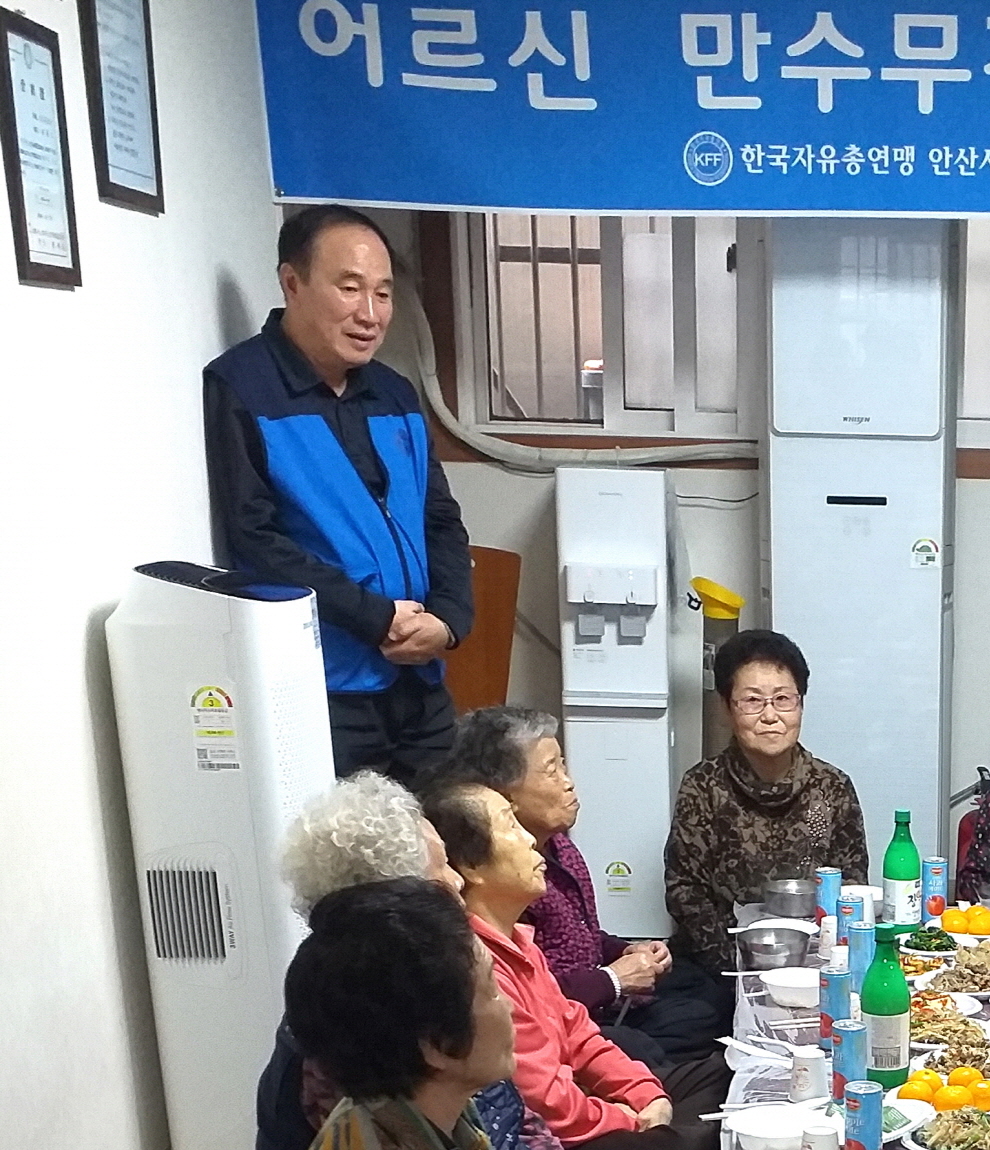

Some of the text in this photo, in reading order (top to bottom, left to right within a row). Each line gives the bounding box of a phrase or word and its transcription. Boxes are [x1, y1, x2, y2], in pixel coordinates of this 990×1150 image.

[298, 0, 598, 112] 어르신
[694, 153, 723, 167] KFF
[739, 143, 916, 177] 한국자유총연맹
